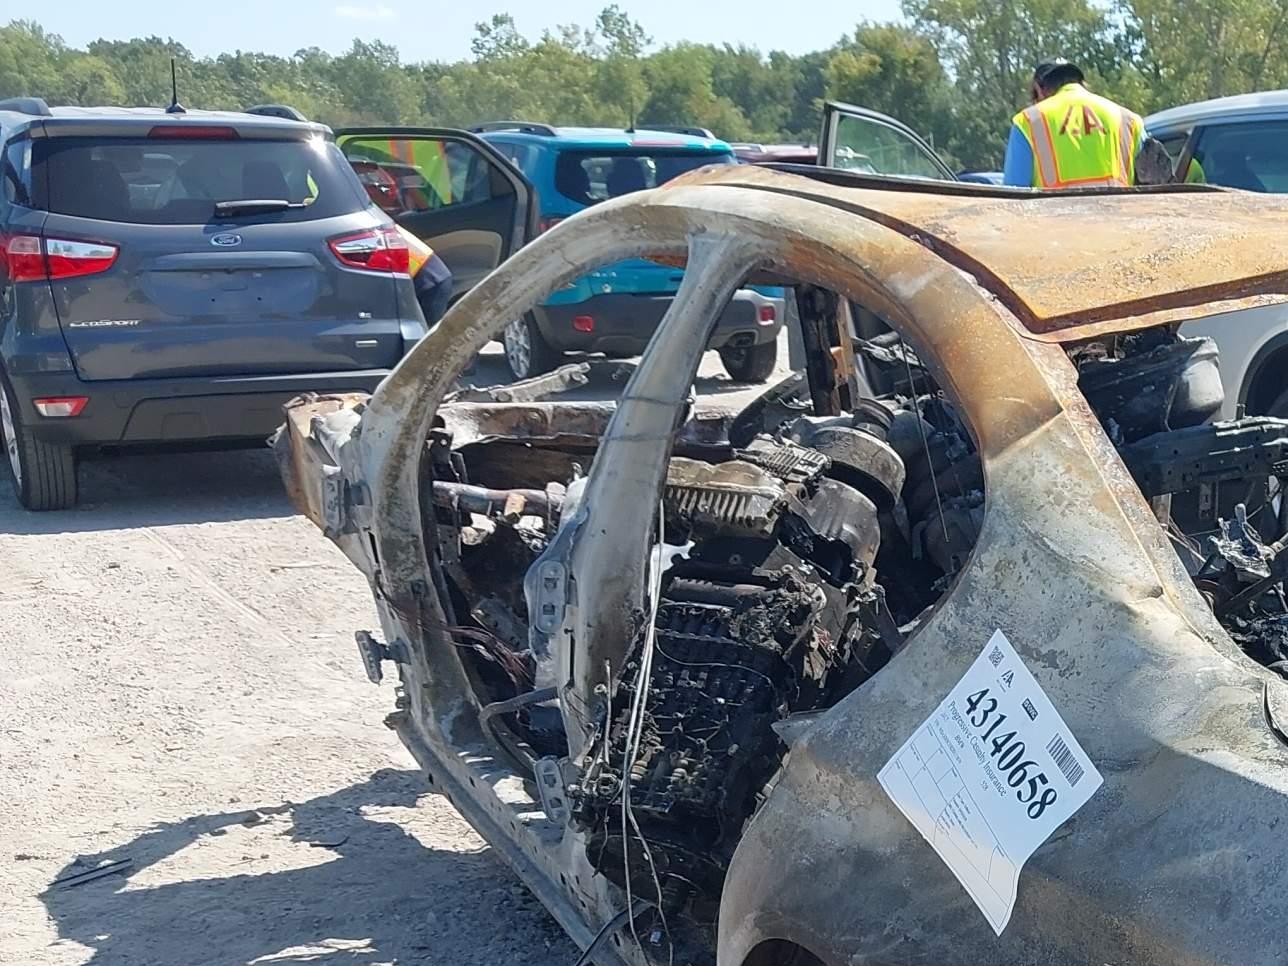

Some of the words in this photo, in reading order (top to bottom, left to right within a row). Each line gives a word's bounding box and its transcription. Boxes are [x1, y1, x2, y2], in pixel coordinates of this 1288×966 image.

[948, 700, 973, 739] Progressive
[983, 761, 1007, 797] Insurance
[964, 688, 1058, 820] 43140658
